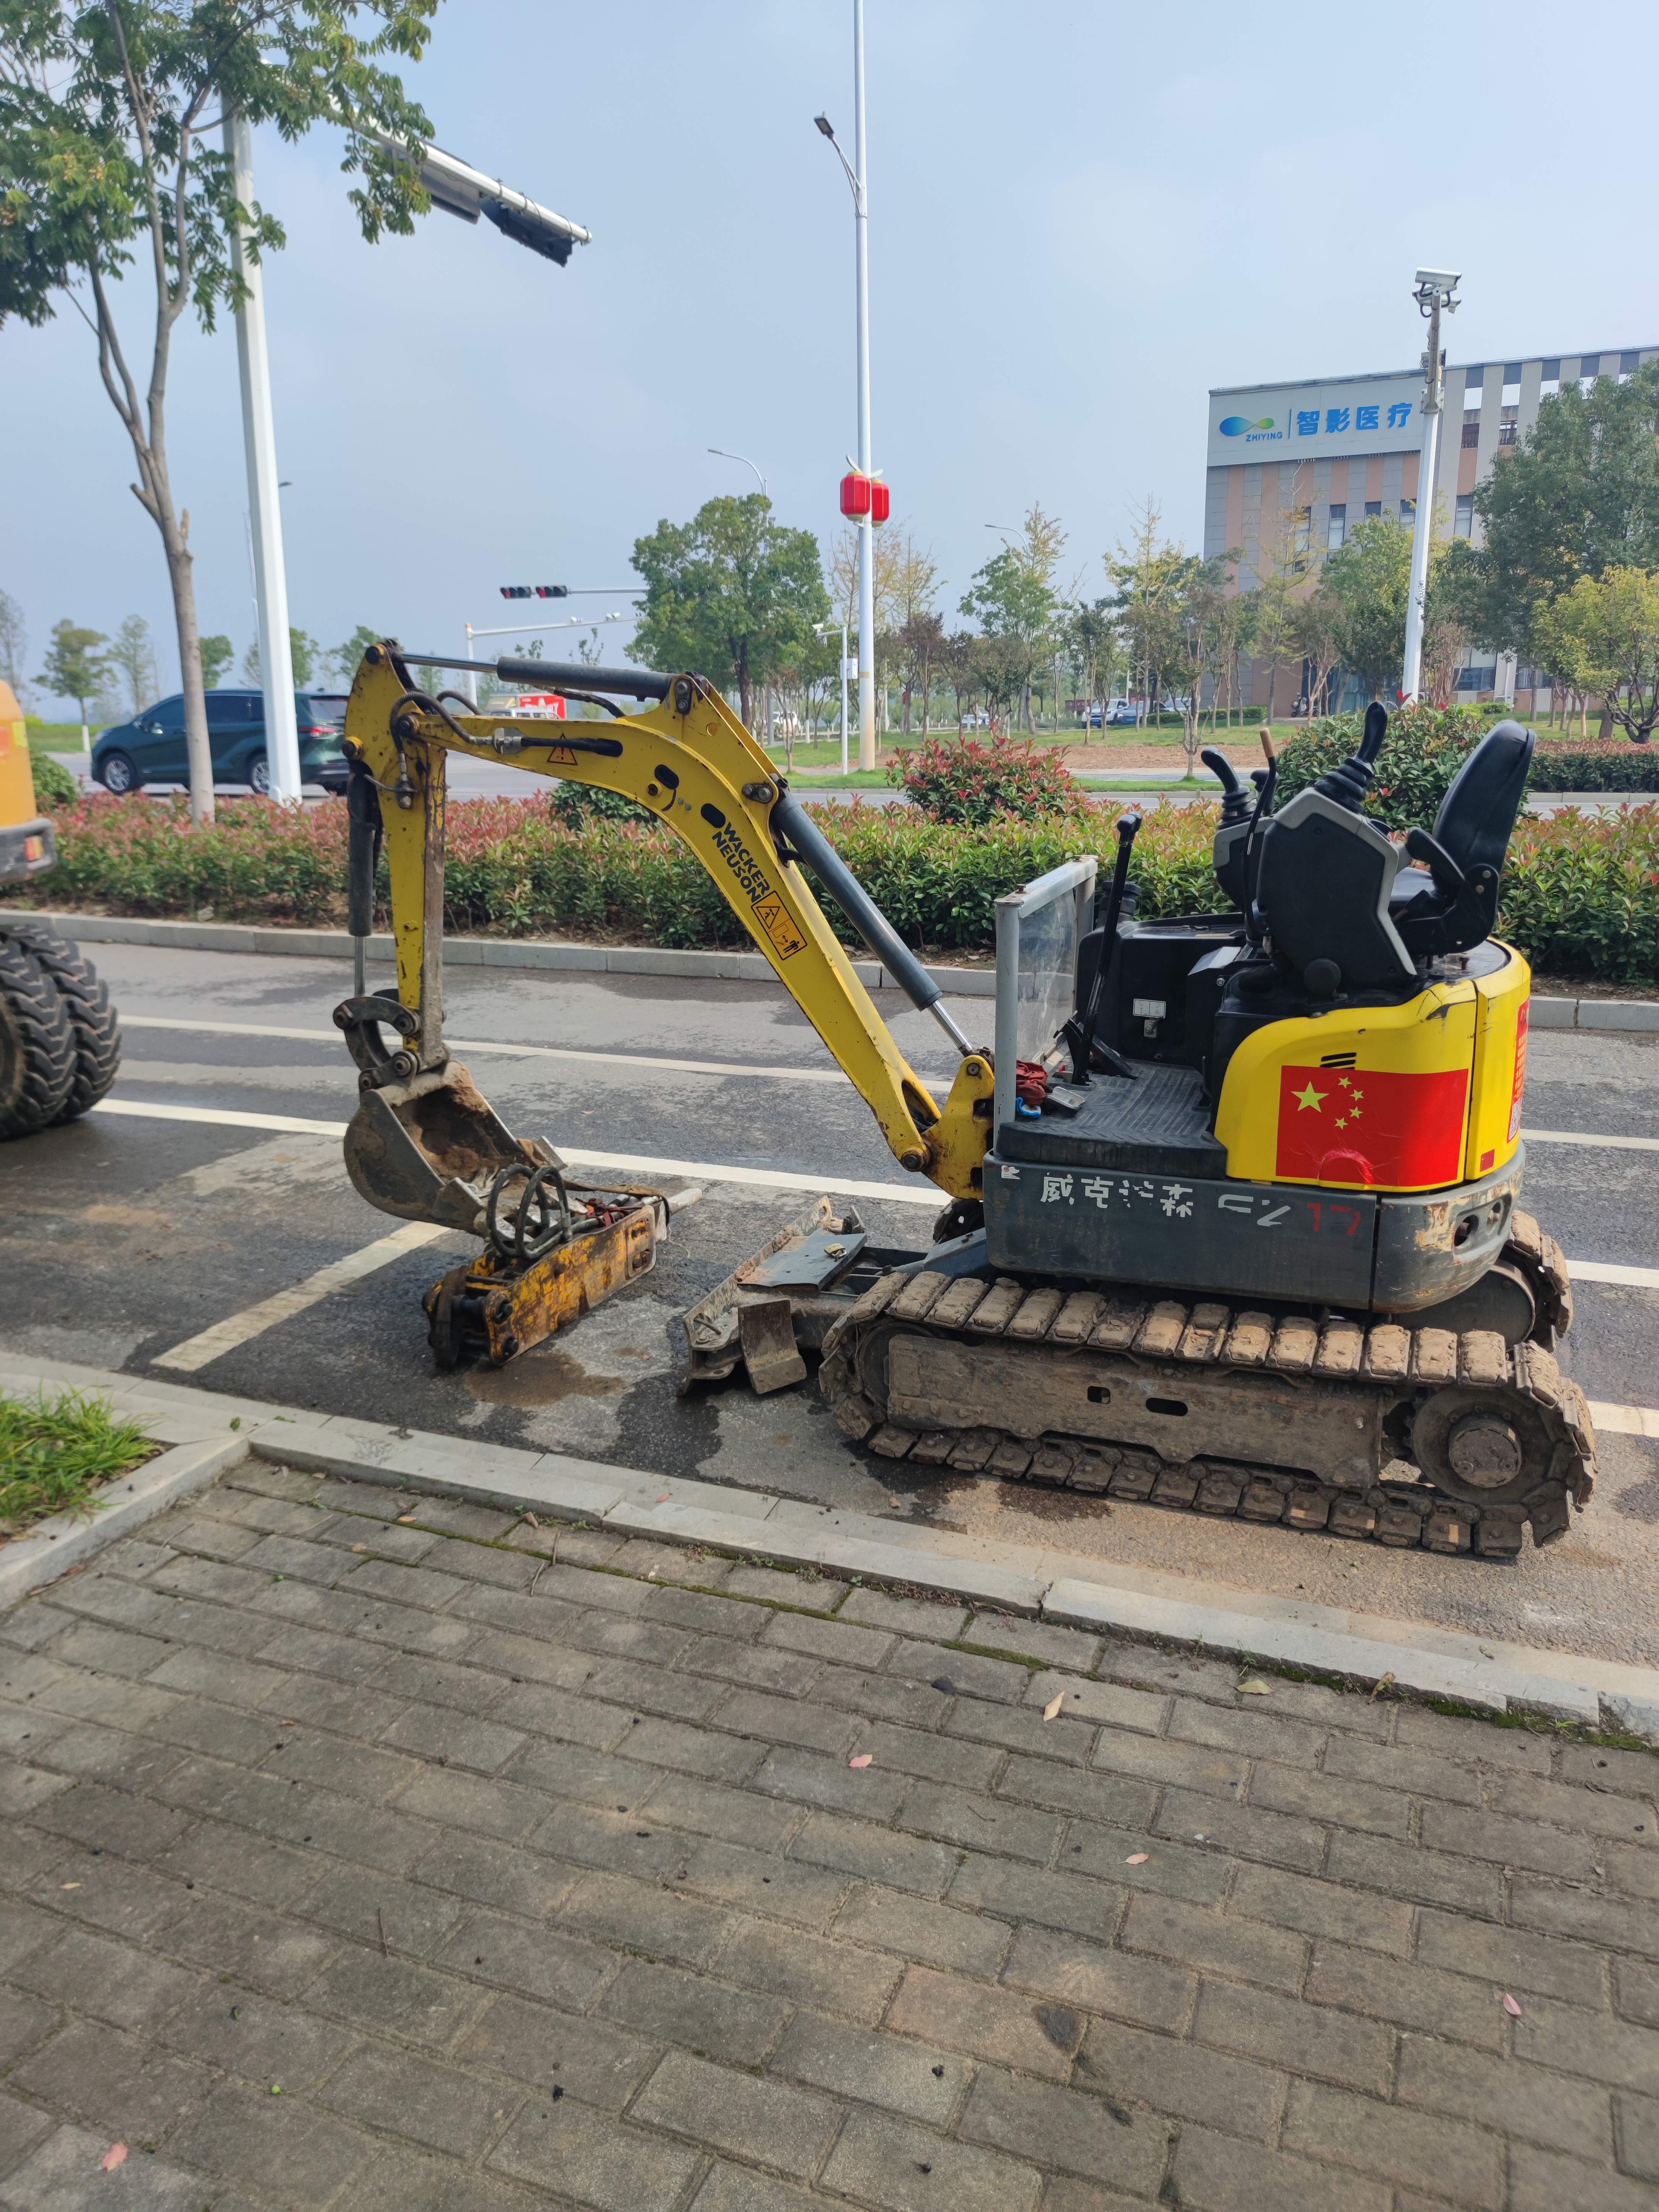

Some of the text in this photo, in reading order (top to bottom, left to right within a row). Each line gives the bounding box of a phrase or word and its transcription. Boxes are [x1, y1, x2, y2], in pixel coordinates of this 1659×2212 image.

[1245, 431, 1283, 442] ZHIYING
[1297, 403, 1413, 436] 智影医疗
[712, 831, 762, 903] NEUSON
[724, 821, 770, 896] WACKER
